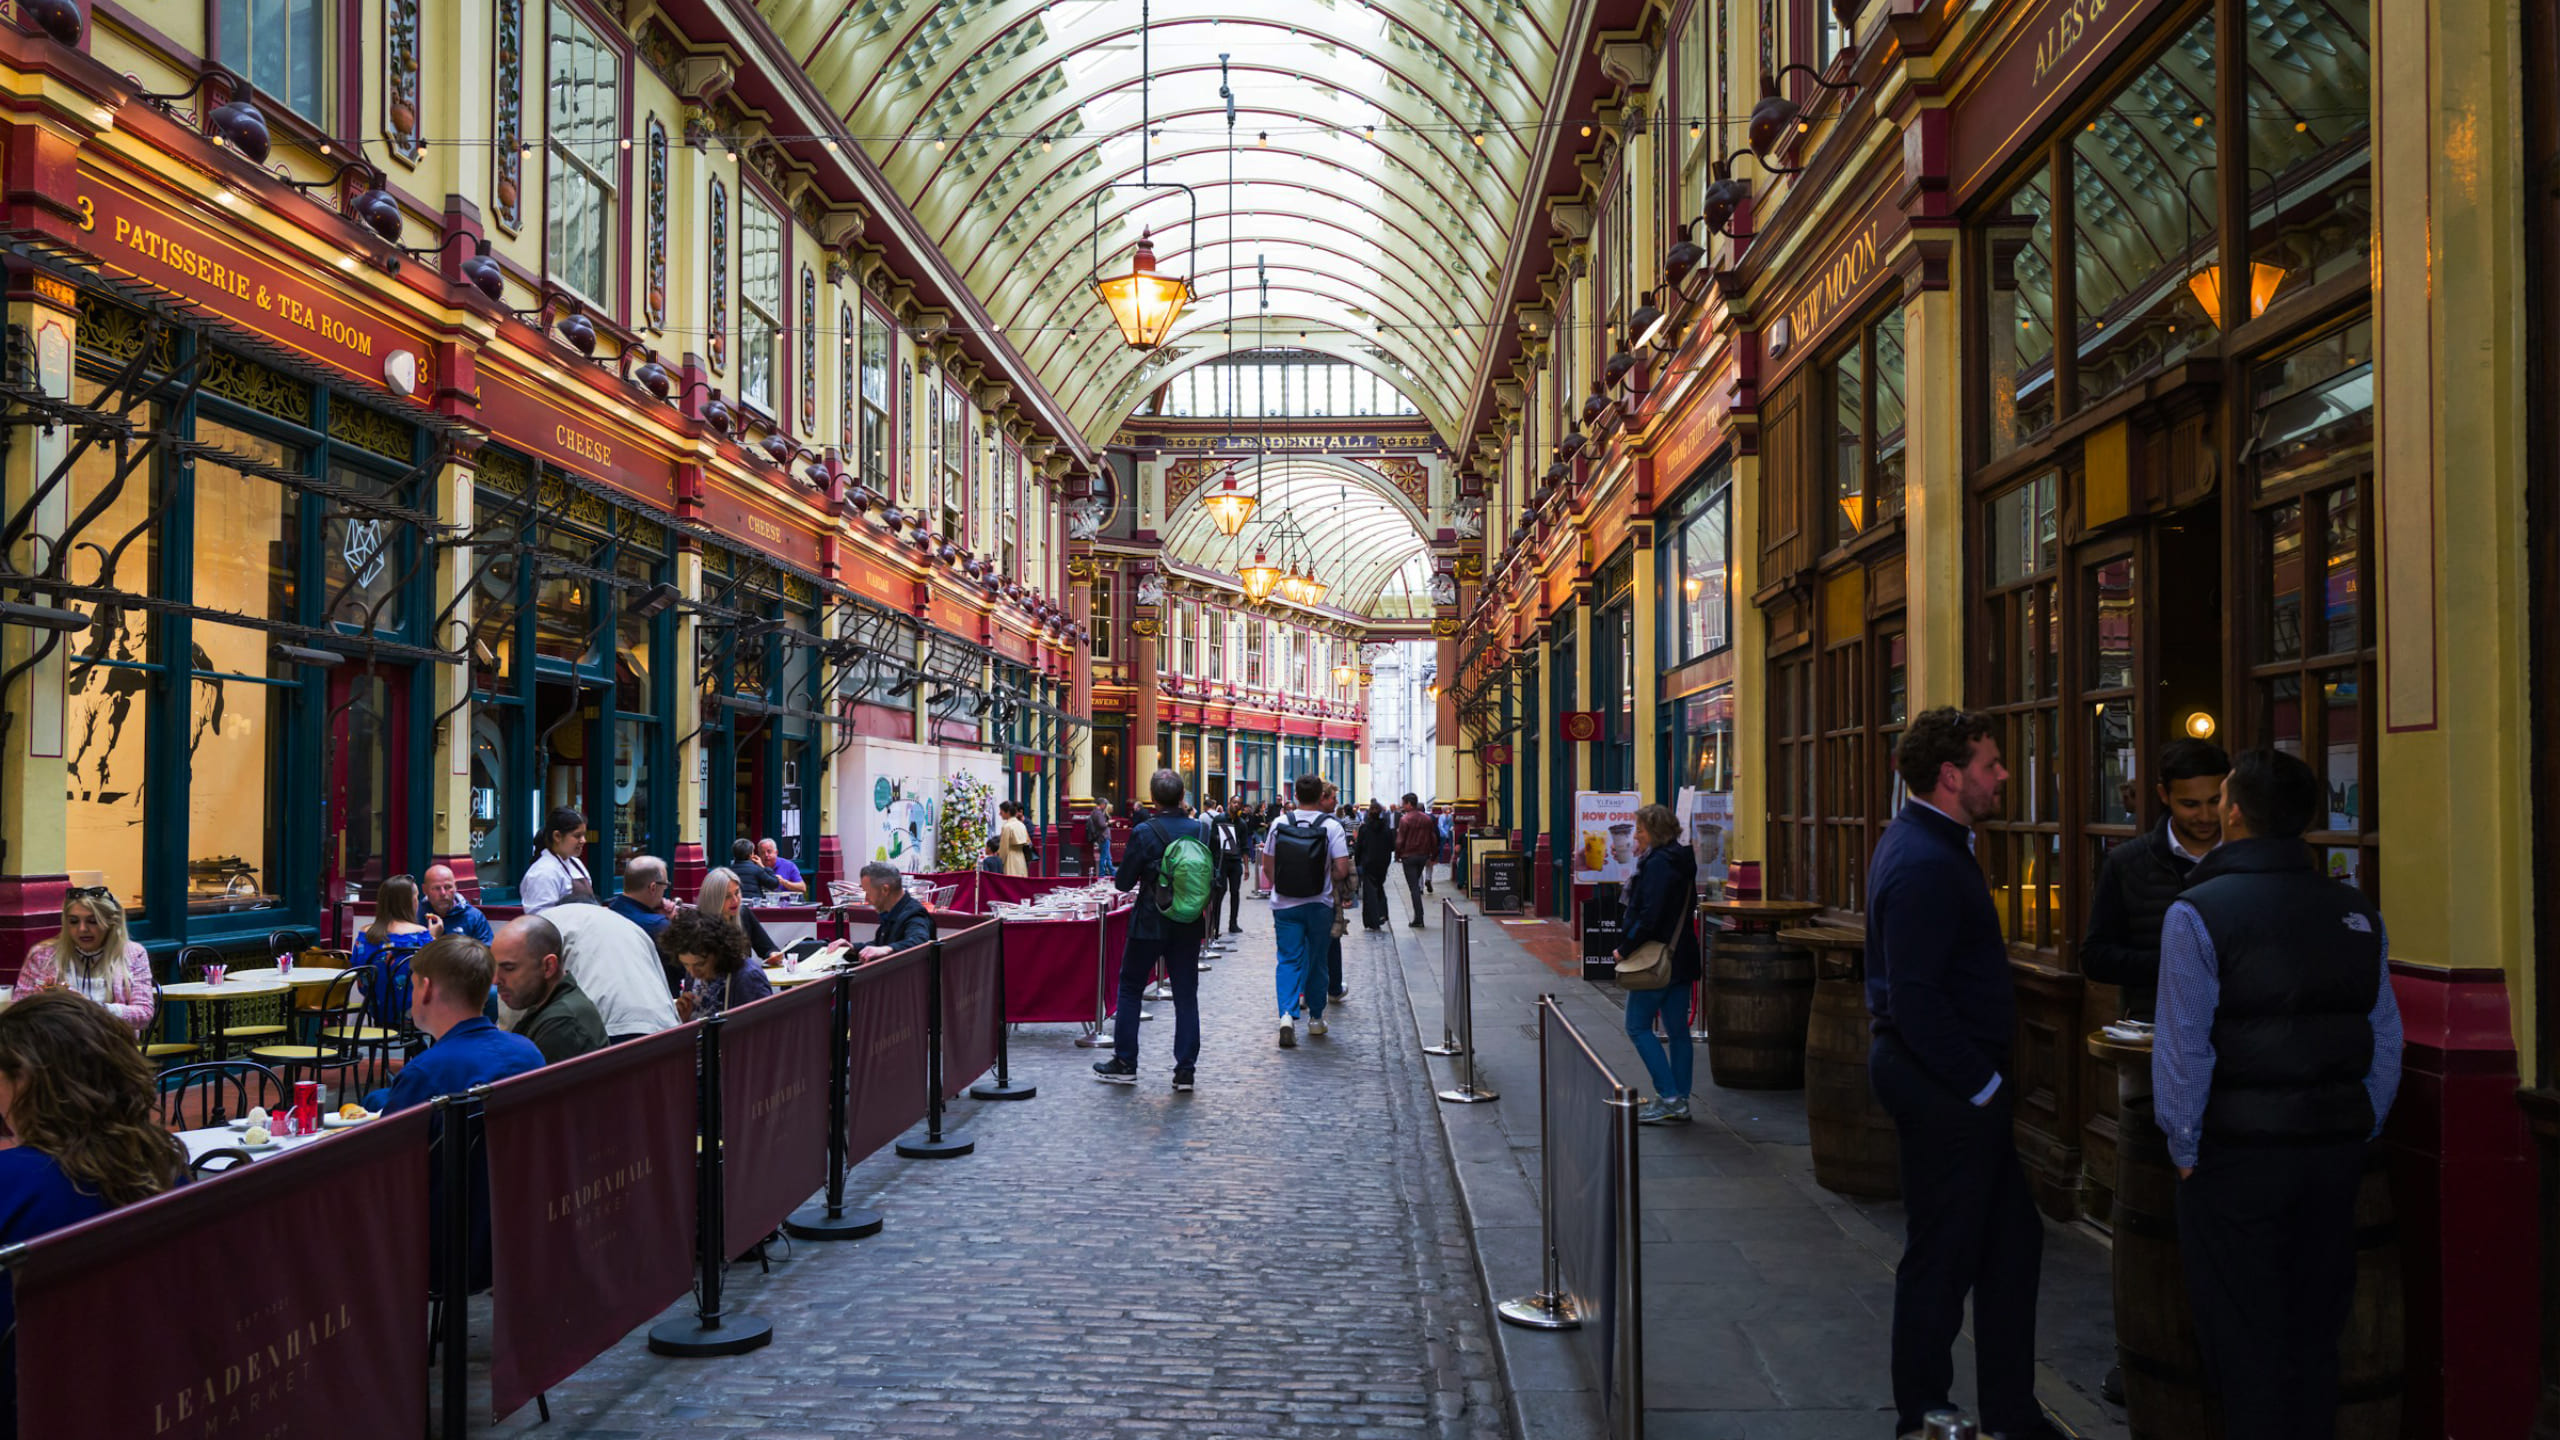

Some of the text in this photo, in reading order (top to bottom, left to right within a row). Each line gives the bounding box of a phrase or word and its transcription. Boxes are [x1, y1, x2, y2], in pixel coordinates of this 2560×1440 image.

[2032, 0, 2084, 88] ALES
[77, 195, 95, 232] 3
[115, 215, 372, 357] PATISSERIE & TEA ROOM
[1790, 220, 1878, 350] NEW MOON
[418, 357, 428, 384] 3
[556, 424, 612, 468] CHEESE
[1225, 436, 1372, 449] LEADENHALL
[666, 476, 674, 496] 4
[748, 514, 782, 544] CHEESE
[1582, 811, 1606, 821] NOW
[548, 1156, 653, 1224] LEADENHALL
[154, 1303, 352, 1436] LEADENHALL
[204, 1360, 311, 1439] MARKET
